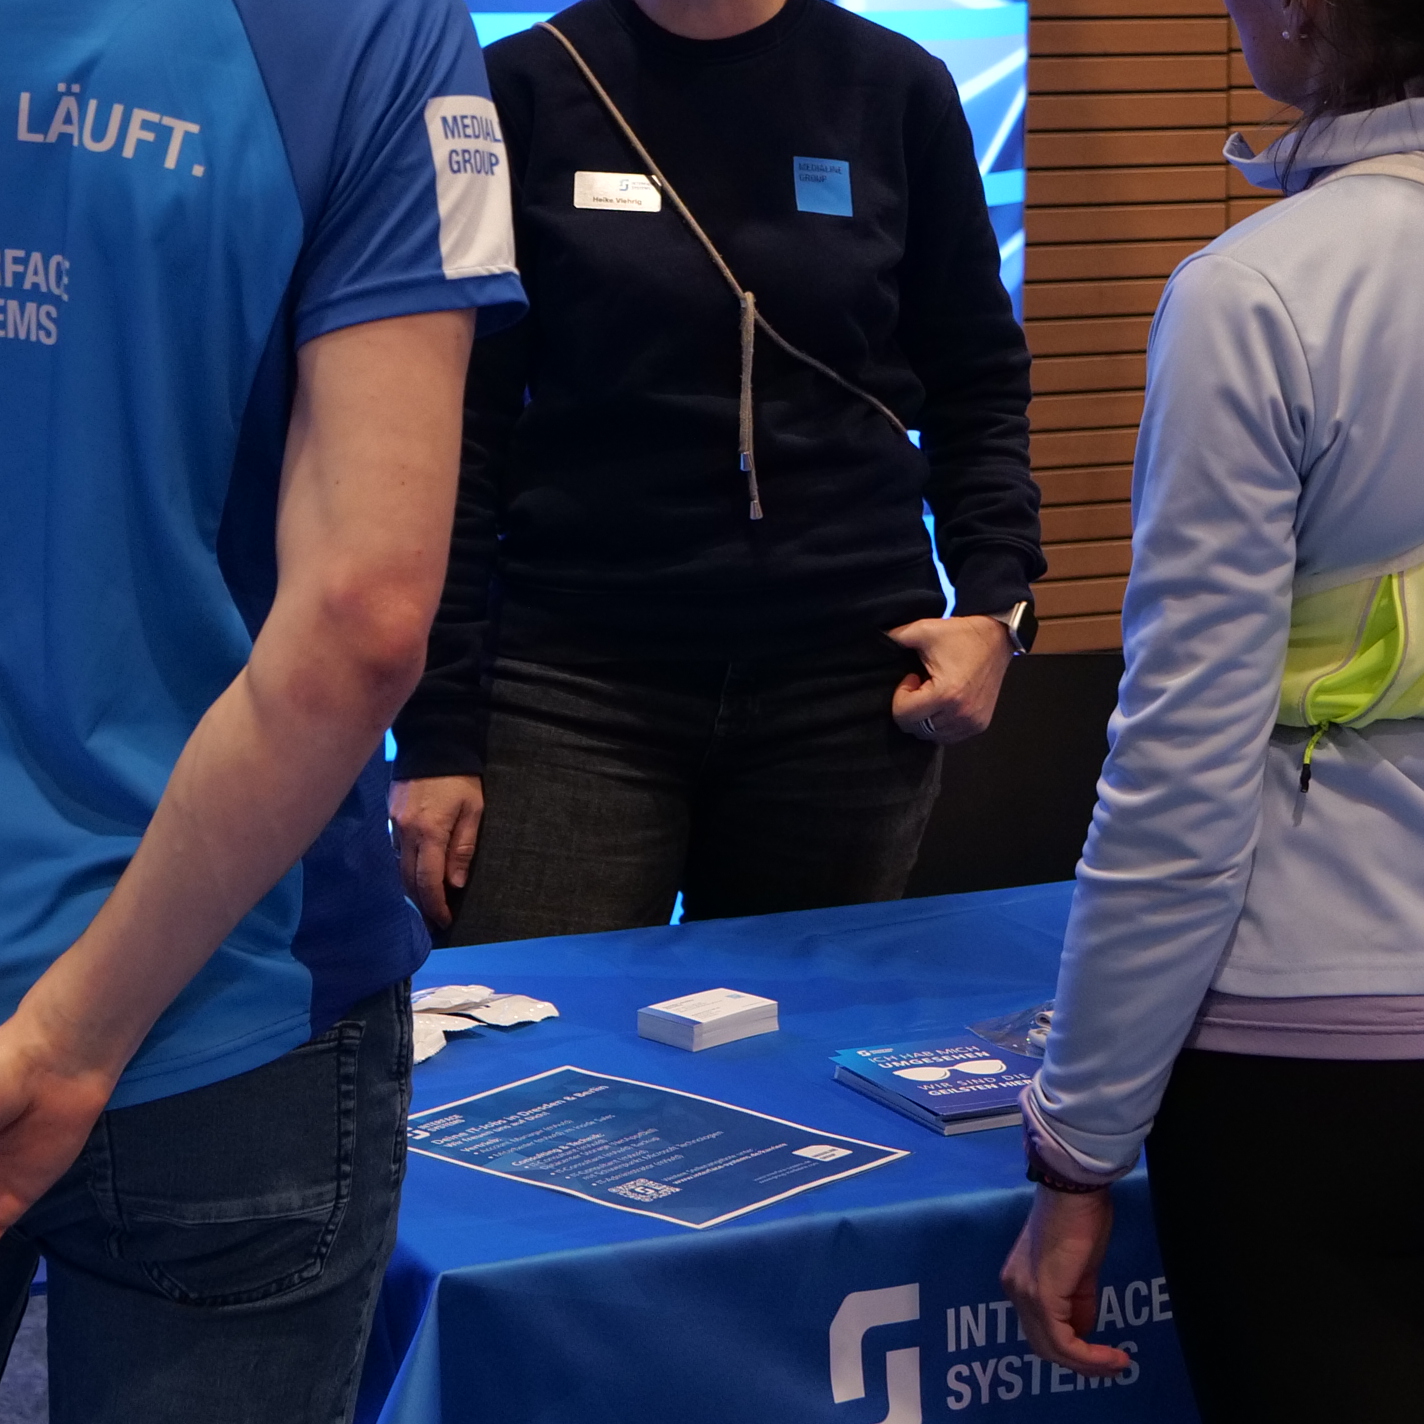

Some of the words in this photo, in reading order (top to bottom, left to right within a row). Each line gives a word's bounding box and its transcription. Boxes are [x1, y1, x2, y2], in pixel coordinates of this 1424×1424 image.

[17, 83, 206, 178] LÄUFT.
[440, 114, 503, 143] MEDIAL
[448, 149, 500, 176] GROUP
[868, 1054, 897, 1064] ICH
[899, 1050, 935, 1062] HAB
[936, 1045, 981, 1056] MICH
[877, 1051, 991, 1069] UMGESEHEN
[917, 1082, 953, 1091] WIR
[956, 1076, 997, 1087] SIND
[1001, 1072, 1031, 1081] DIE
[927, 1082, 999, 1097] GEILSTEN
[431, 1132, 468, 1144] Deine
[517, 1100, 566, 1116] Dresden
[573, 1086, 609, 1097] Berlin
[946, 1276, 1174, 1353] INTACE
